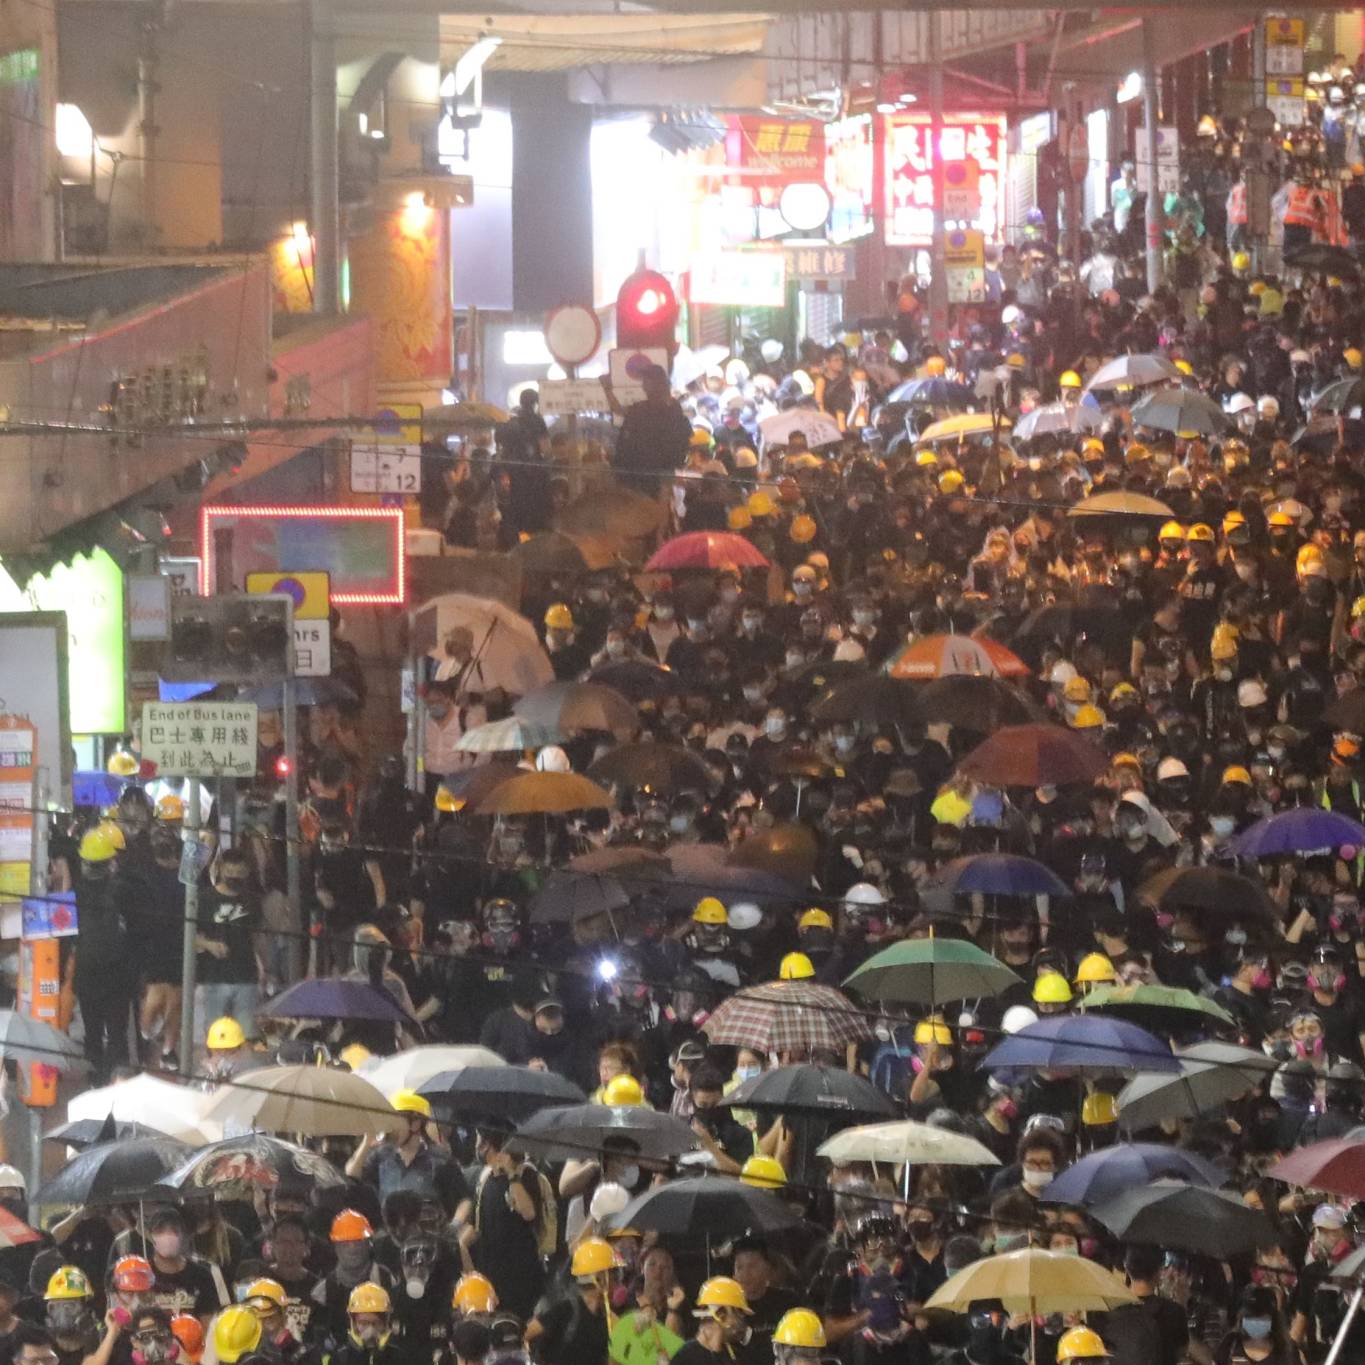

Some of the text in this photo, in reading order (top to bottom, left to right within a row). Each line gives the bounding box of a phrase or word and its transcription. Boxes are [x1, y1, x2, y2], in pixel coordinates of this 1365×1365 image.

[396, 474, 417, 491] 12
[150, 709, 251, 721] End of Bus lane
[161, 750, 236, 768] 到此為止
